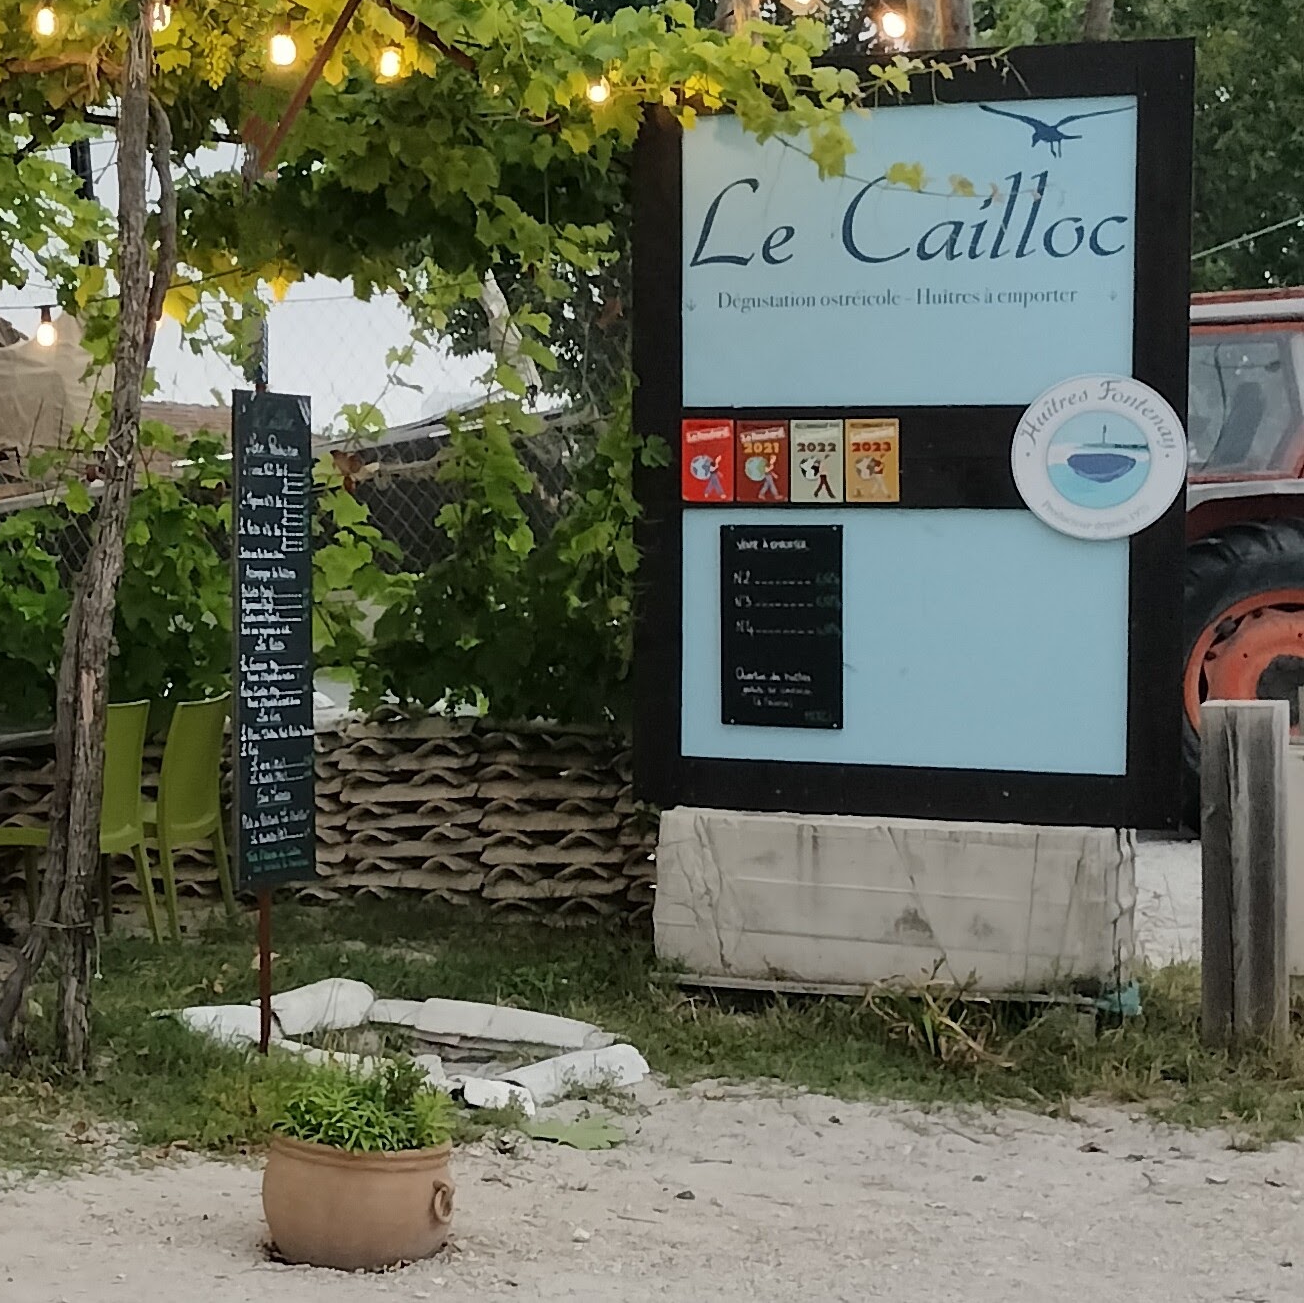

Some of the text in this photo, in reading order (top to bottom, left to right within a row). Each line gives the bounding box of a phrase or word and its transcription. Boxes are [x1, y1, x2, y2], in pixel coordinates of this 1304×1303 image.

[689, 170, 1129, 268] Le Cailloc
[984, 287, 993, 304] à
[997, 289, 1079, 309] emporter
[1097, 380, 1177, 449] Fontenay
[743, 442, 780, 454] 2021
[796, 442, 837, 453] 2022
[851, 441, 892, 452] 2023
